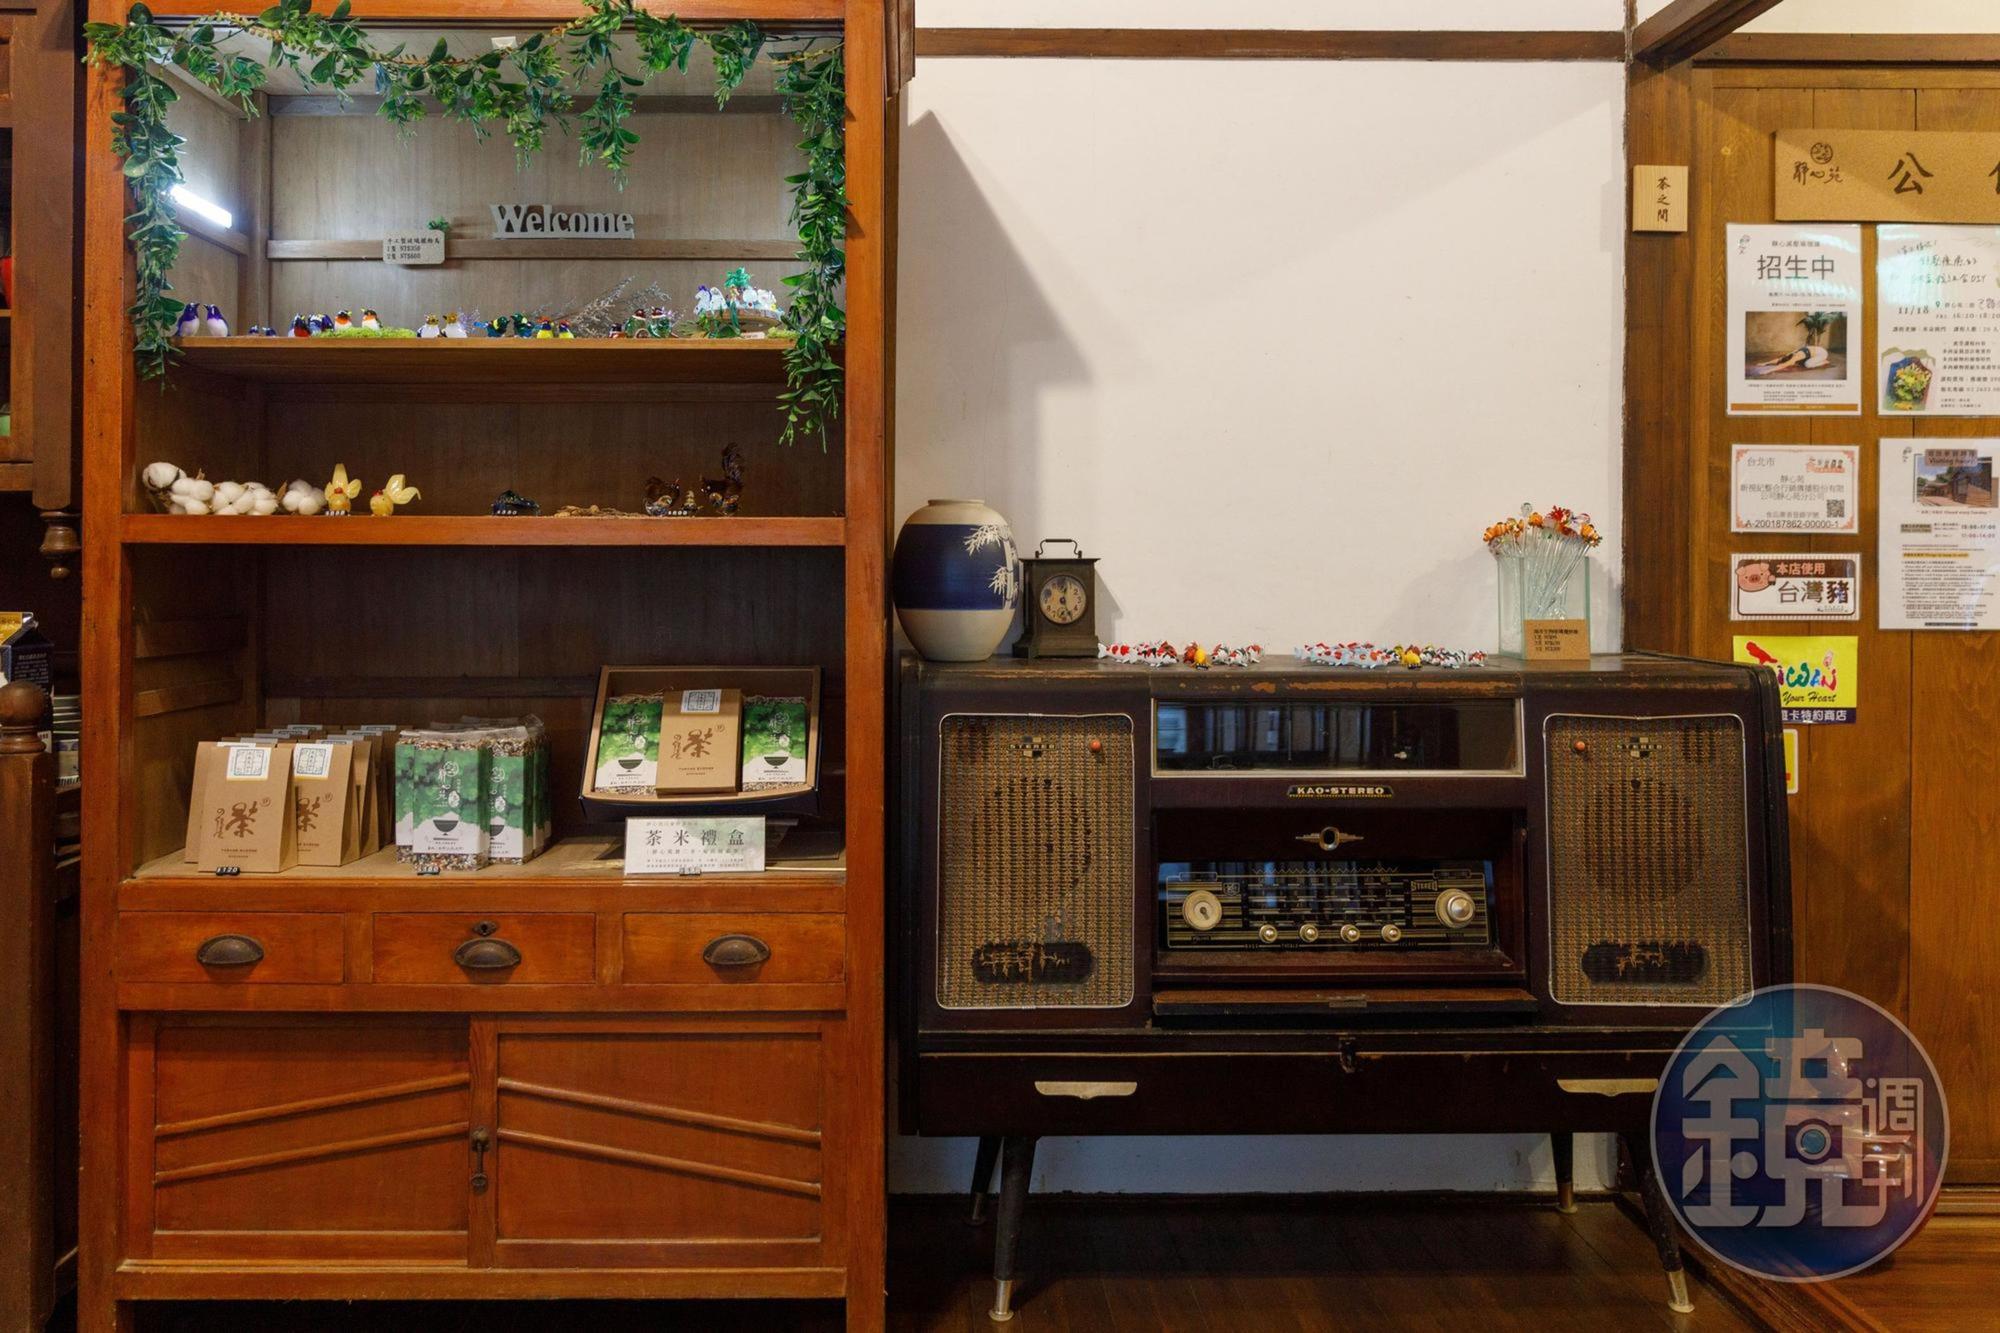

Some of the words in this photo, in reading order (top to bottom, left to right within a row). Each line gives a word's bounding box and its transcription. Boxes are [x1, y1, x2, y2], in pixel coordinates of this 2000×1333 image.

[1656, 175, 1672, 223] 茶之間
[490, 204, 635, 239] Welcome
[1756, 254, 1835, 280] 招生中
[1747, 457, 1776, 467] 台北市
[1776, 562, 1826, 576] 本店使用
[1778, 580, 1850, 604] 台灣豬
[1782, 691, 1805, 705] Your
[1807, 691, 1837, 703] Heart
[1296, 787, 1385, 795] KAO-STEREO
[646, 828, 745, 846] 茶米禮盒
[1410, 880, 1438, 891] STEREO
